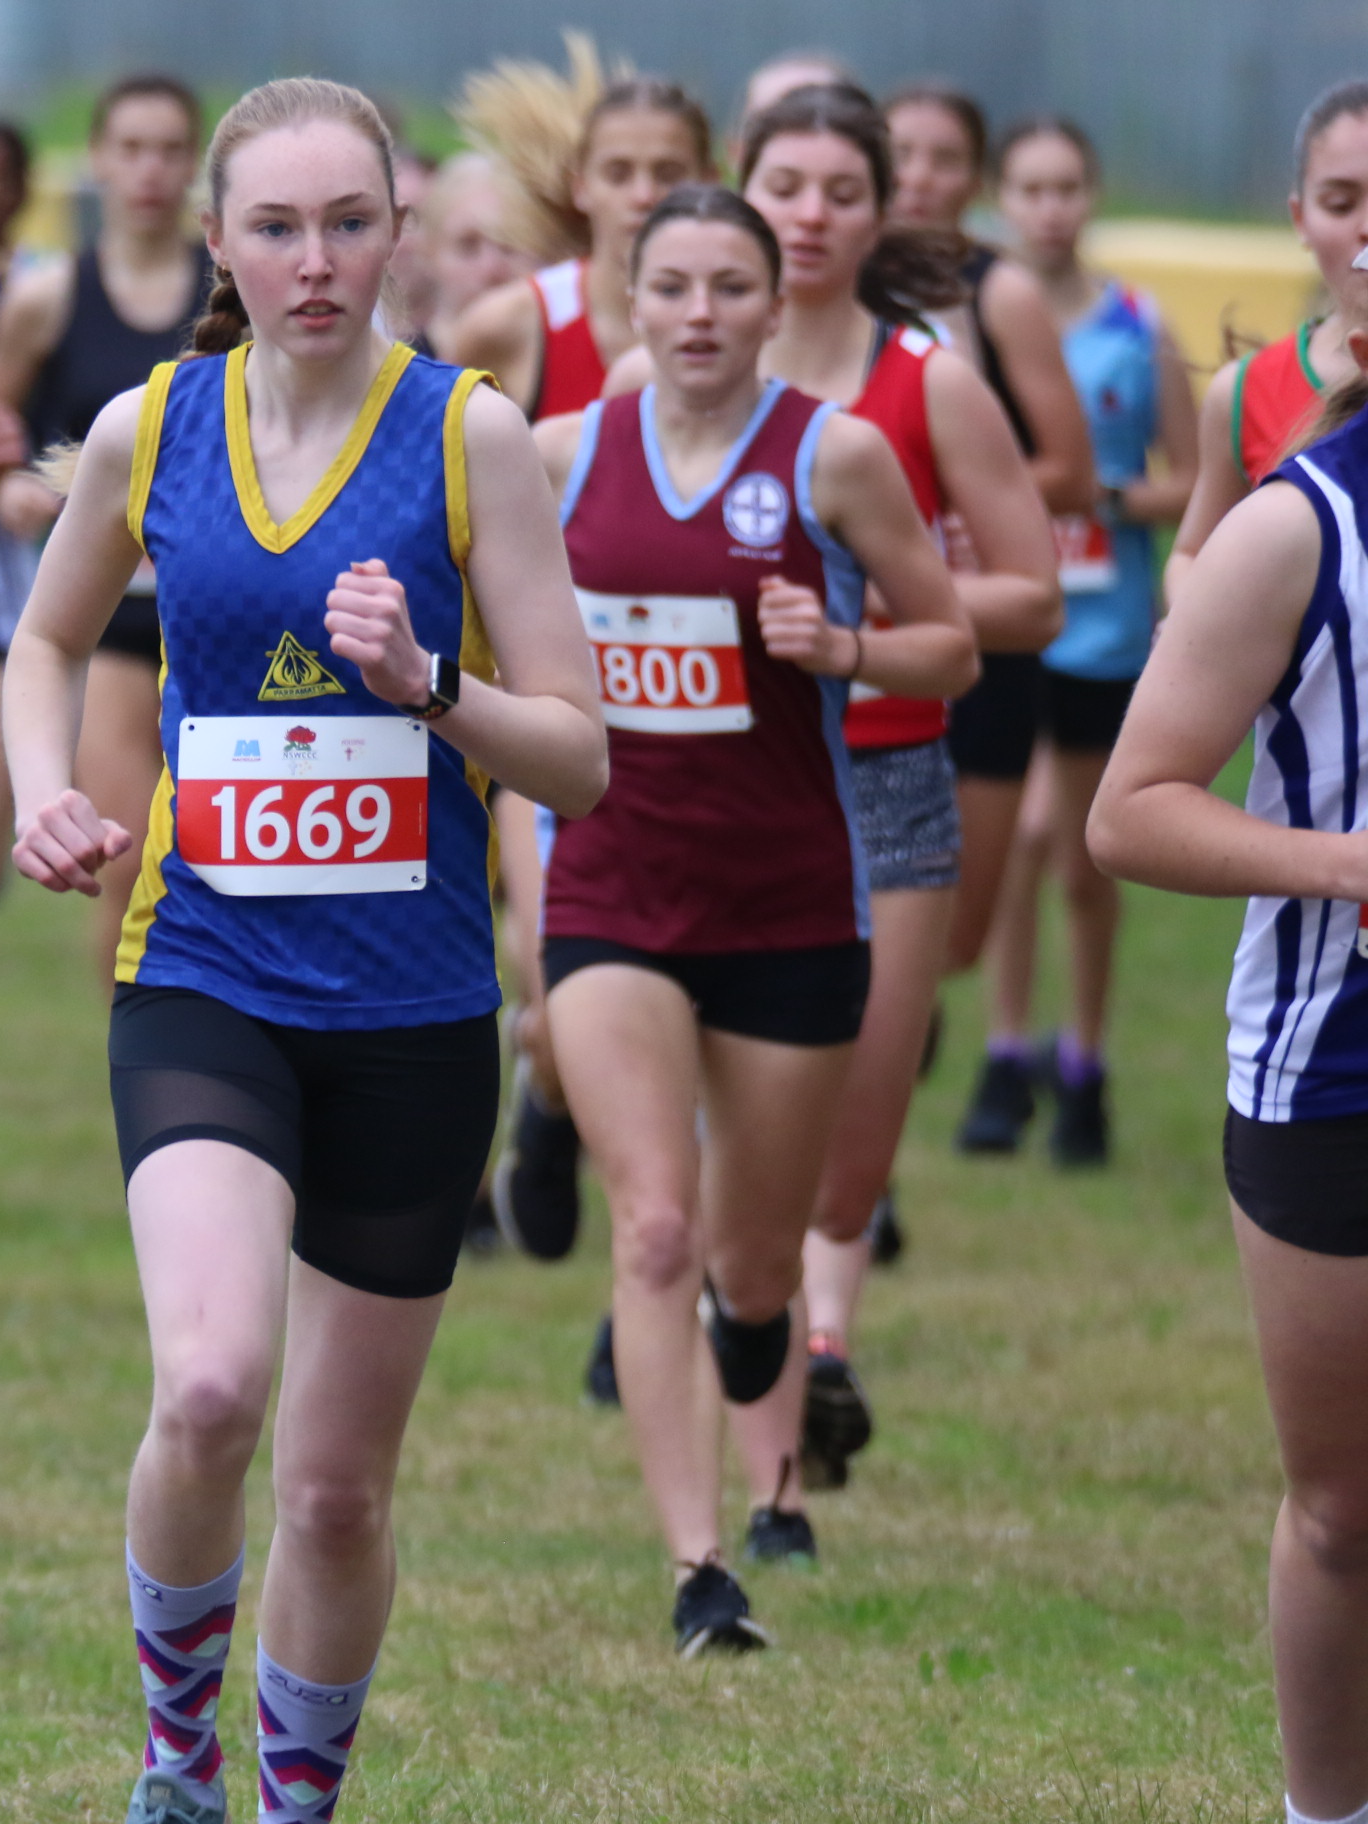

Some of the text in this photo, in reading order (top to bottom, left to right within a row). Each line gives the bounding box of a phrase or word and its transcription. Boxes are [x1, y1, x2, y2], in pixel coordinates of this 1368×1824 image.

[273, 684, 326, 697] PARRAMATTA
[283, 751, 317, 759] NSWCCC
[211, 784, 391, 861] 1669
